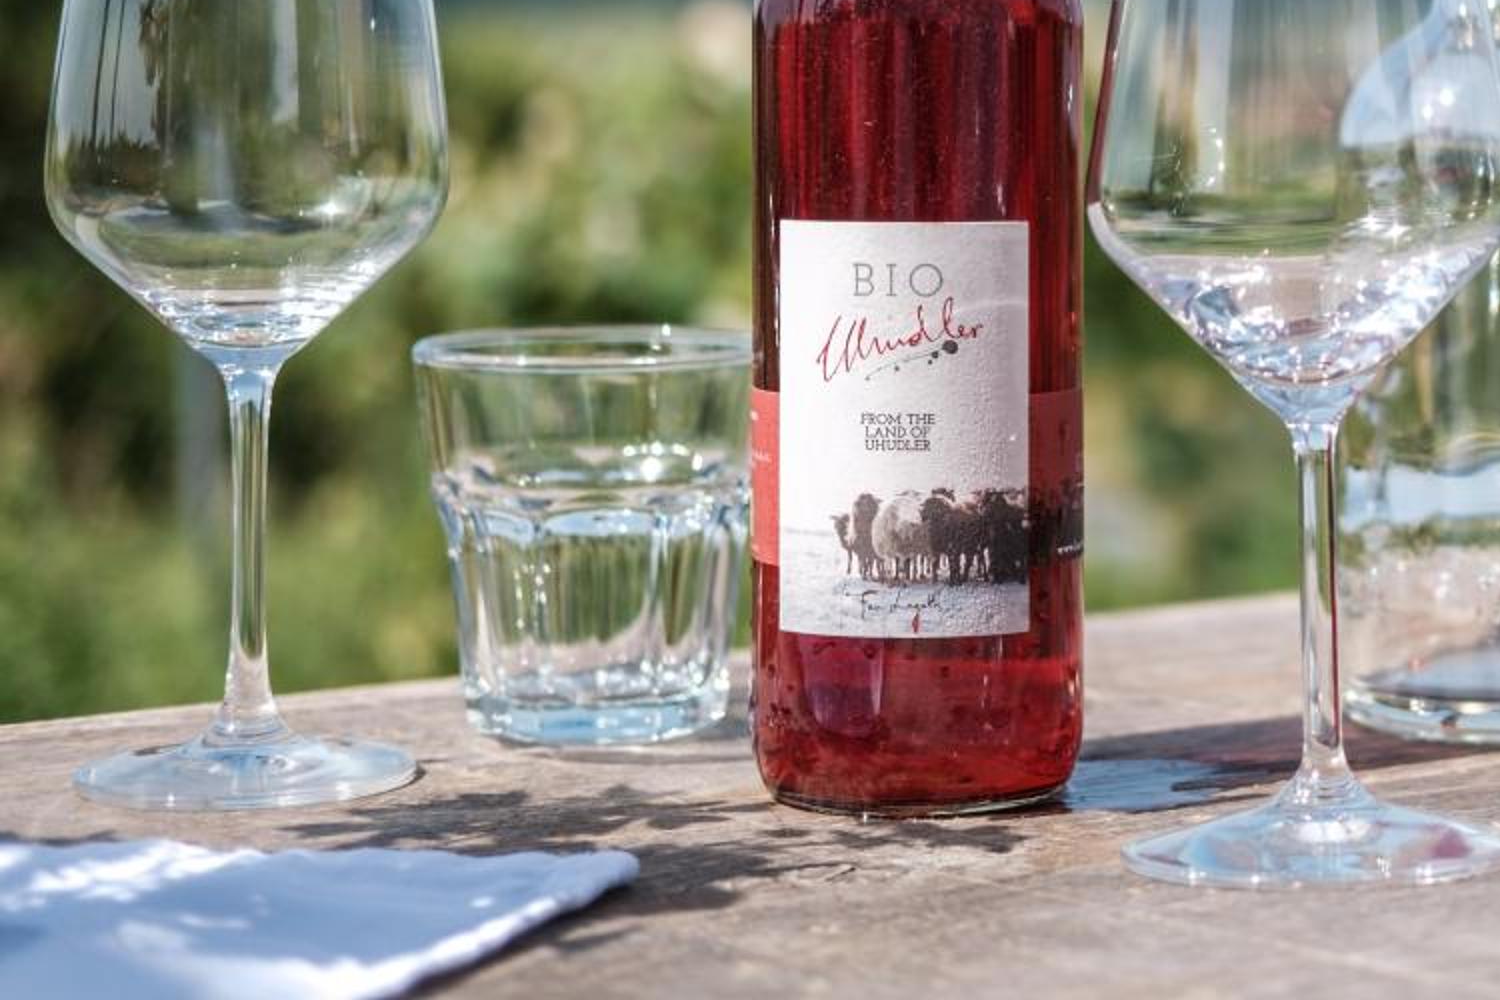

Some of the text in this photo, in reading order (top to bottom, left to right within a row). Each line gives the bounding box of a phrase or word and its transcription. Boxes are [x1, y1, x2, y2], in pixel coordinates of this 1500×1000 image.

[852, 262, 944, 298] BIO
[860, 412, 936, 425] FROM THE
[865, 426, 931, 439] LAND OF
[865, 439, 931, 452] UHUDLER
